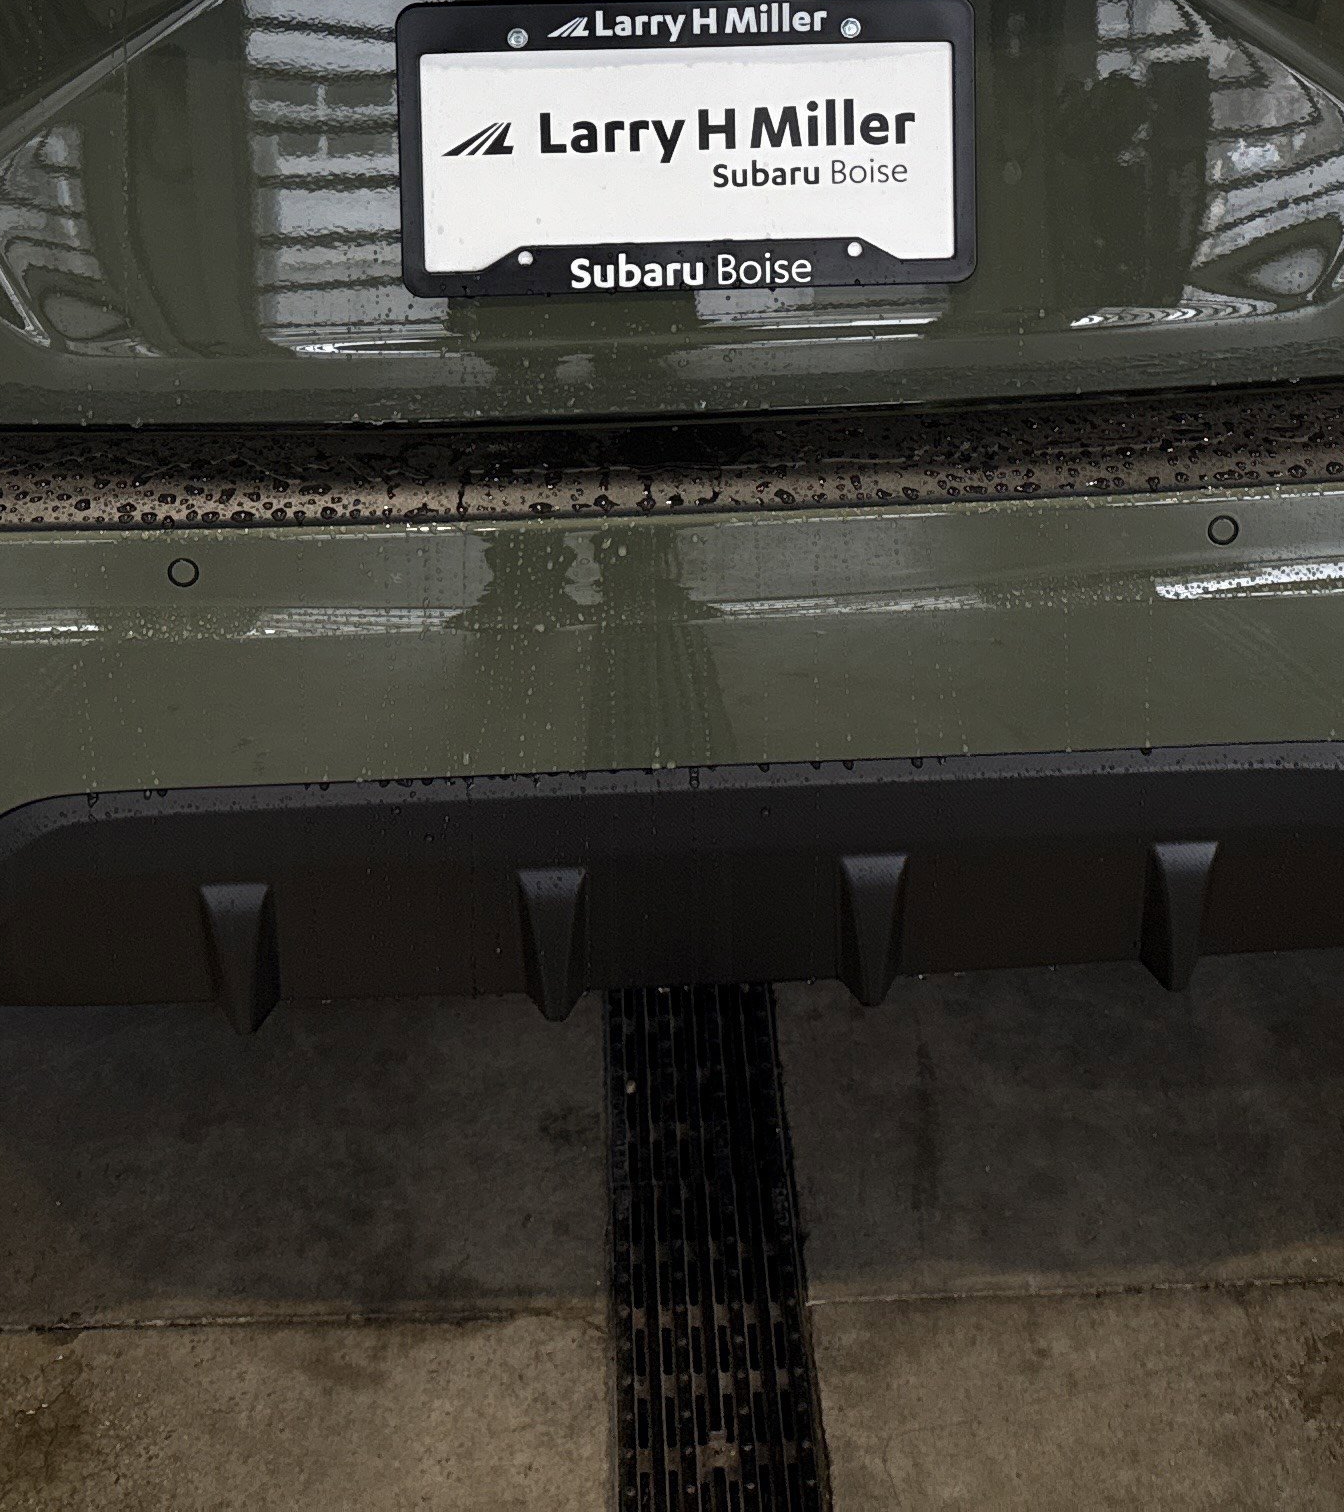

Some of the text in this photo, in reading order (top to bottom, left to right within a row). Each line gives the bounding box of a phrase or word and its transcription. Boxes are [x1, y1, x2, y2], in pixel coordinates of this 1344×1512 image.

[595, 2, 827, 42] Larry H Miller
[539, 98, 916, 164] Larry H Miller
[712, 158, 908, 188] Subaru Boise
[570, 252, 812, 289] Subaru Boise
